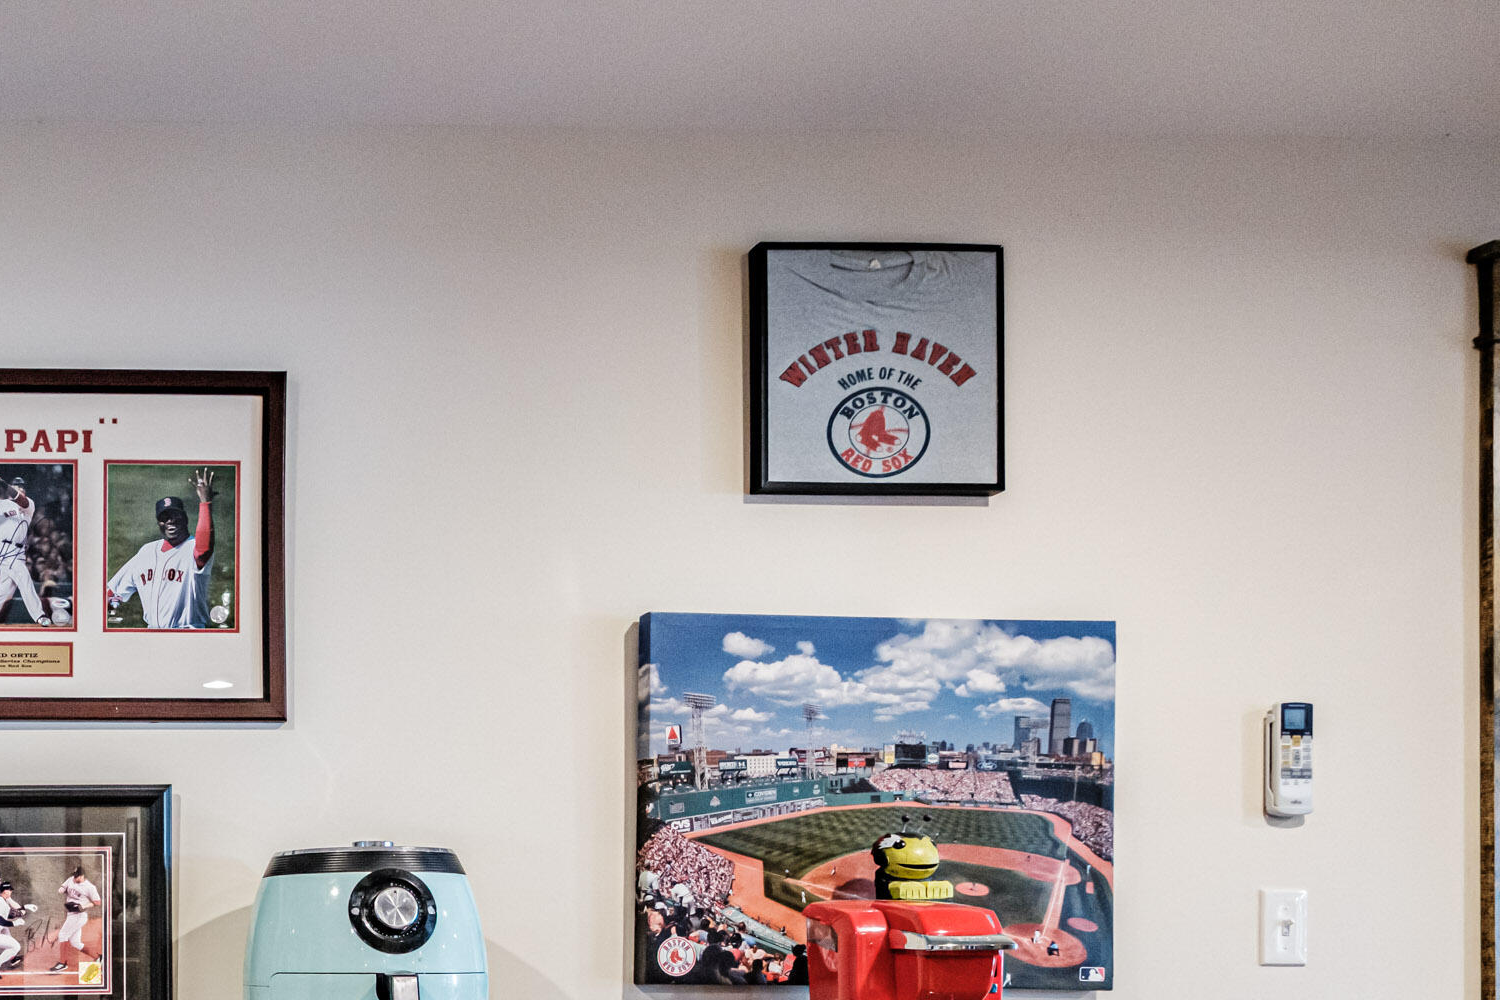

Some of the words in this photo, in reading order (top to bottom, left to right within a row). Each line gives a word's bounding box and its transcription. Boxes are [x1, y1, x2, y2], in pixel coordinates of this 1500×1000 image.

[779, 329, 880, 388] WINTER
[892, 331, 977, 387] HAVEN
[837, 367, 874, 390] HOME
[879, 366, 895, 380] OF
[899, 370, 922, 390] THE
[839, 391, 920, 420] BOSTON
[841, 447, 873, 473] RED
[882, 447, 914, 473] SOX
[670, 820, 691, 830] CVS
